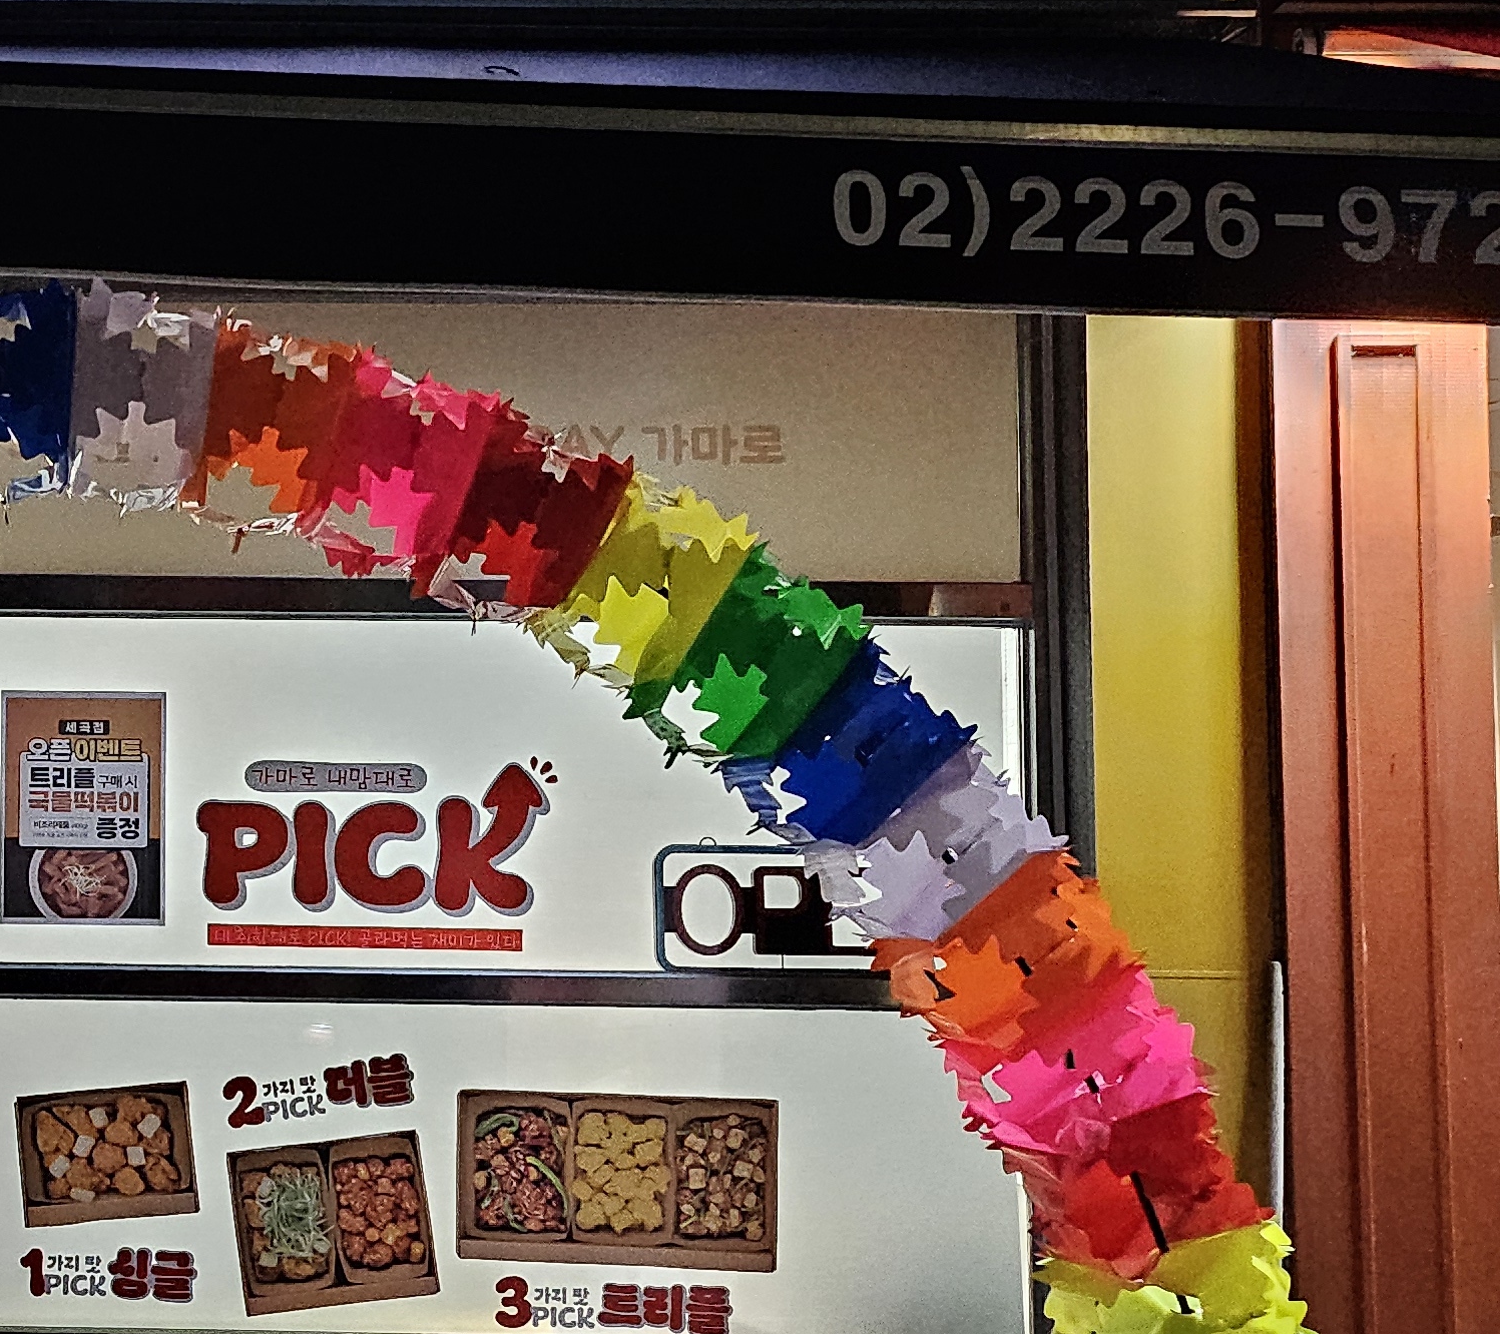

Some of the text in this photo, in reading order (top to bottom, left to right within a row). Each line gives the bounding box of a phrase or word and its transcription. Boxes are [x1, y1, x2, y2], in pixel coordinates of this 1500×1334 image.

[641, 423, 787, 465] 가마로
[26, 738, 144, 762] 오픈 이벤트
[29, 767, 95, 789] 트리플
[252, 766, 416, 790] 가마로 내맘대로
[27, 790, 139, 813] 국물떡볶이
[96, 817, 140, 840] 증정
[196, 762, 551, 918] PICK
[428, 932, 482, 949] 재미가
[323, 1052, 415, 1109] 더블
[222, 1075, 317, 1129] 2 가지 맛
[262, 1093, 327, 1123] PICK
[19, 1247, 102, 1298] 1 가지 맛
[44, 1273, 107, 1297] PICK
[107, 1246, 198, 1303] 싱글
[495, 1275, 590, 1329] 3 가지 맛
[531, 1306, 596, 1329] PICK
